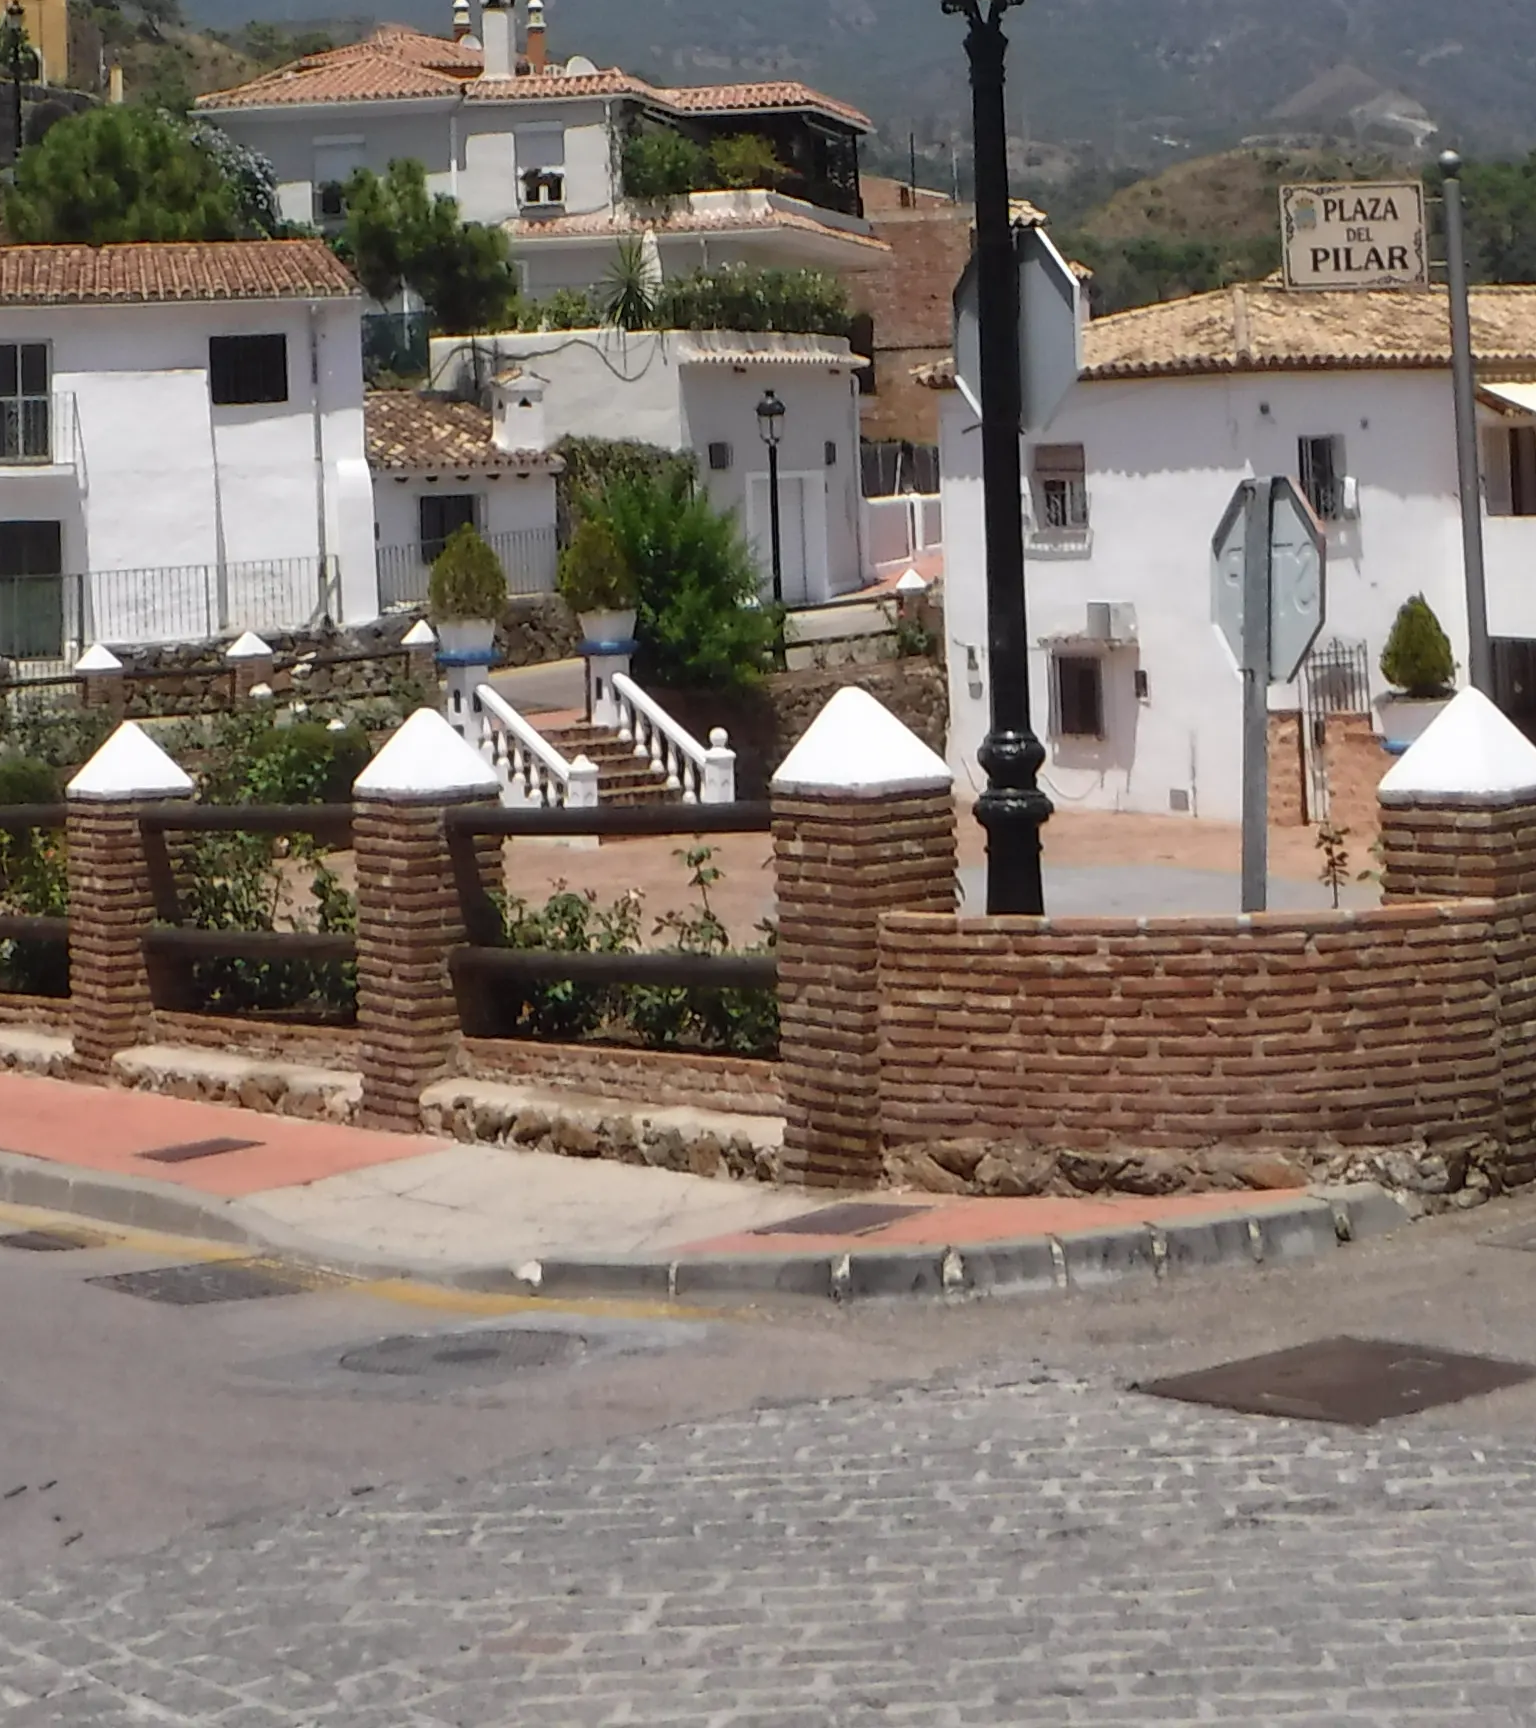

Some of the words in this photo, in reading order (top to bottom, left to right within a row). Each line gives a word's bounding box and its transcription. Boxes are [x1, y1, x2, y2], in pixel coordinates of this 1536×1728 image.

[1323, 197, 1398, 222] PLAZA
[1346, 227, 1373, 242] DEL
[1310, 246, 1409, 272] PILAR
